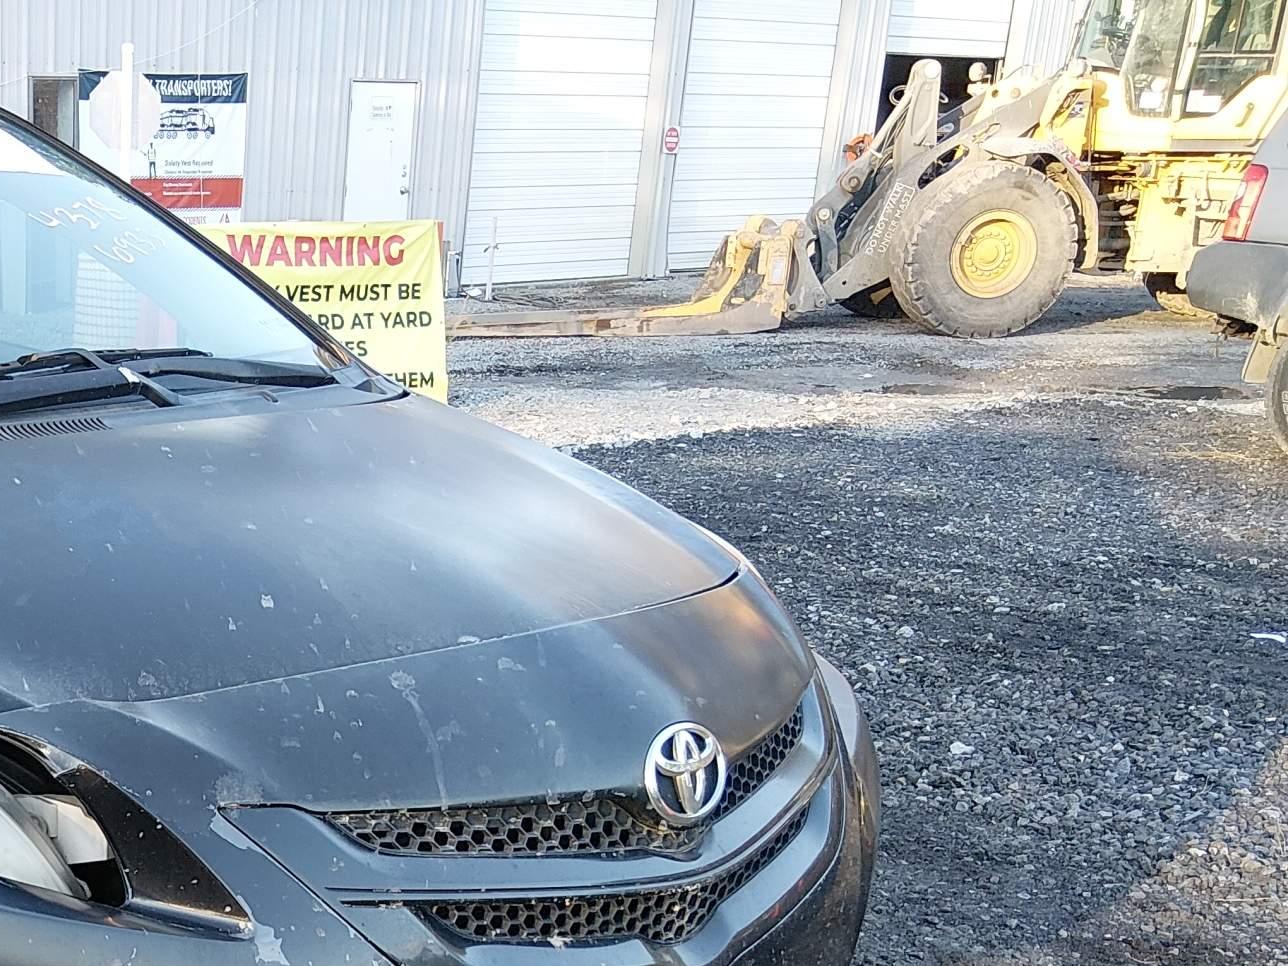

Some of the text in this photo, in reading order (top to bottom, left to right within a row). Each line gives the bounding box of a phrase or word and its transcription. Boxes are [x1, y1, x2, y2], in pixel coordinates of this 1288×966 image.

[874, 215, 889, 239] NOT
[226, 234, 405, 267] WARNING
[286, 283, 421, 302] VEST MUST BE
[309, 311, 432, 331] RD AT YARD
